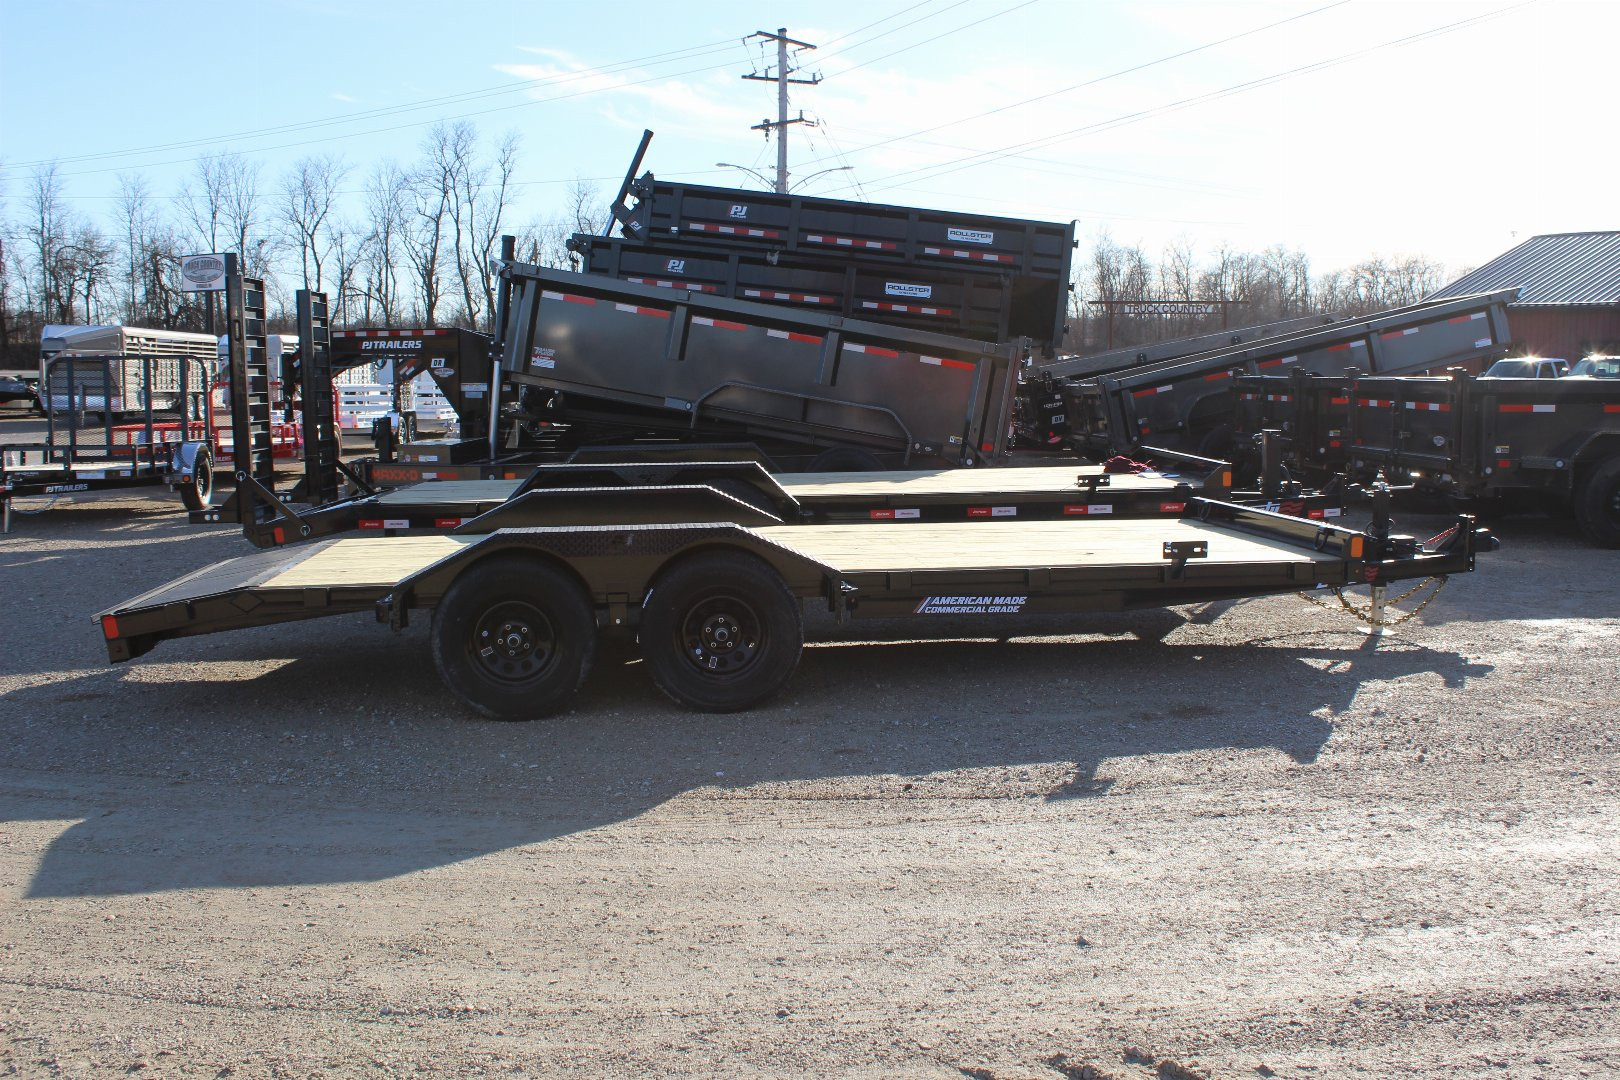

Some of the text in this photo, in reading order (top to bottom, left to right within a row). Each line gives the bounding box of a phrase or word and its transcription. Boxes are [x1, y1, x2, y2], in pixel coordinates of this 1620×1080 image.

[729, 205, 748, 216] PJ
[949, 230, 992, 239] ROLLSTER
[667, 260, 685, 270] PJ
[887, 284, 930, 293] ROLLSTER
[1127, 304, 1211, 313] TRUCK COUNTRY
[931, 596, 1027, 605] AMERICAN MADE
[924, 605, 1021, 614] COMMERCIAL GRADE
